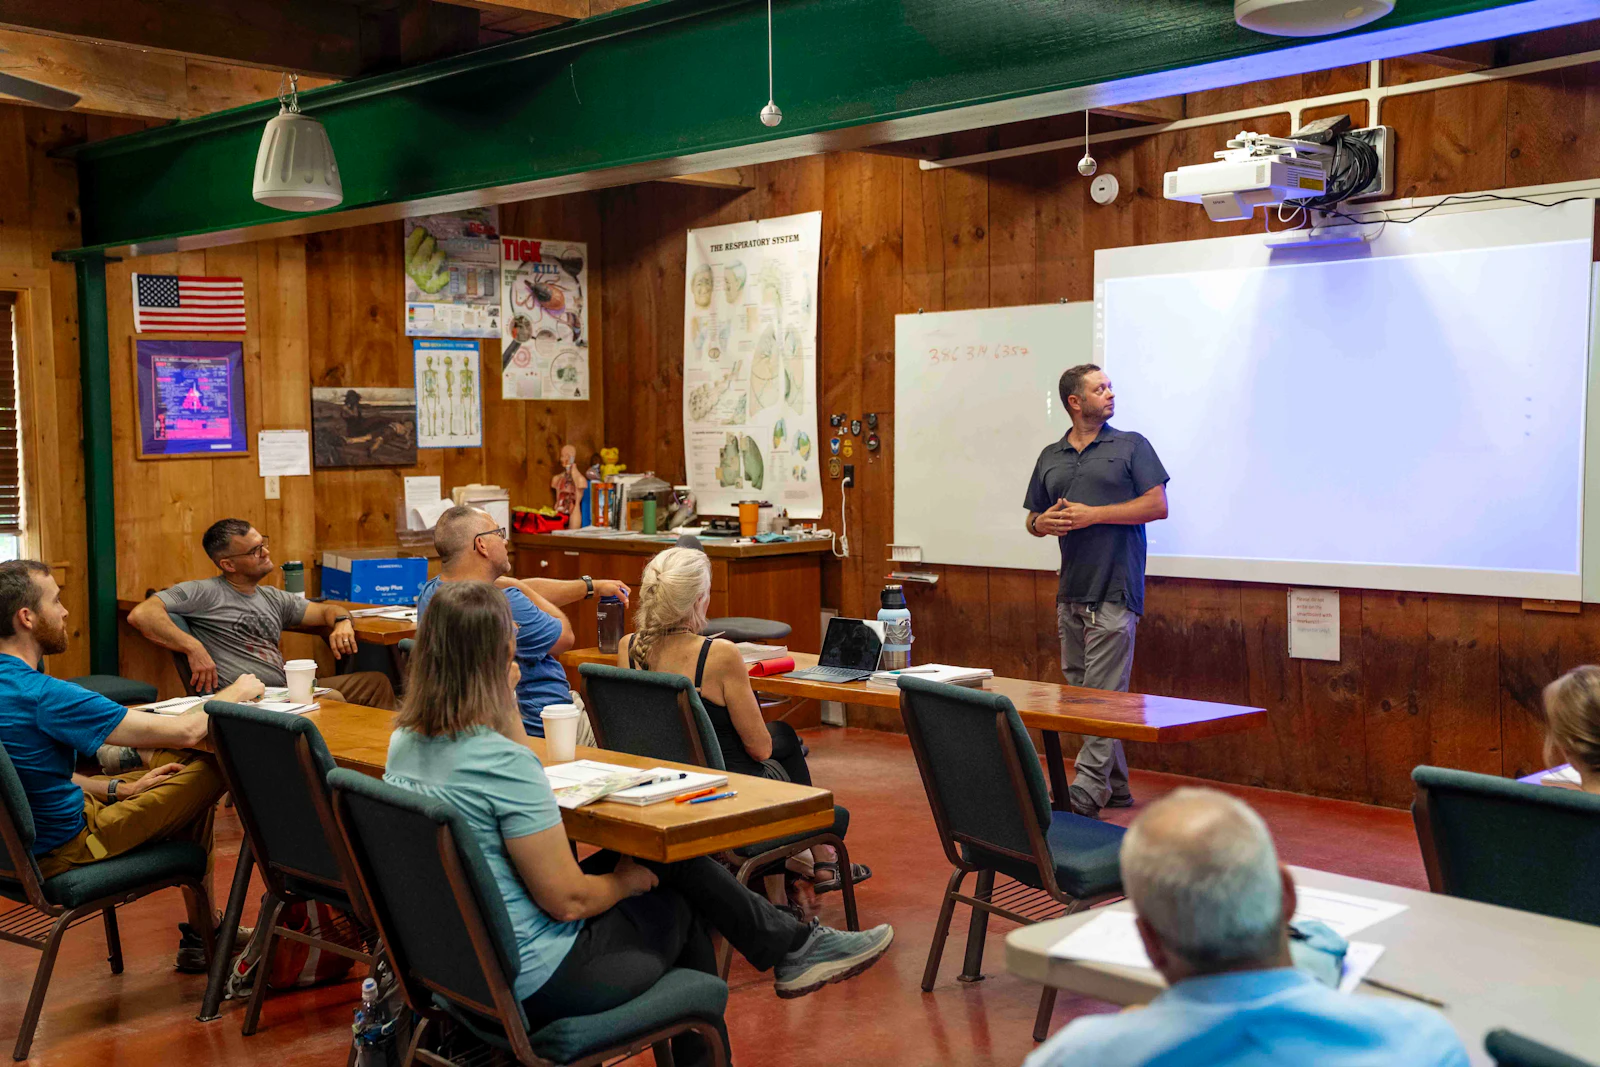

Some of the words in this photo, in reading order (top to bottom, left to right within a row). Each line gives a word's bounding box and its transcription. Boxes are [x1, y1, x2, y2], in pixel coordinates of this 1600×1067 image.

[710, 243, 724, 252] THE
[724, 237, 771, 251] RESPIRATORY
[771, 233, 800, 245] SYSTEM
